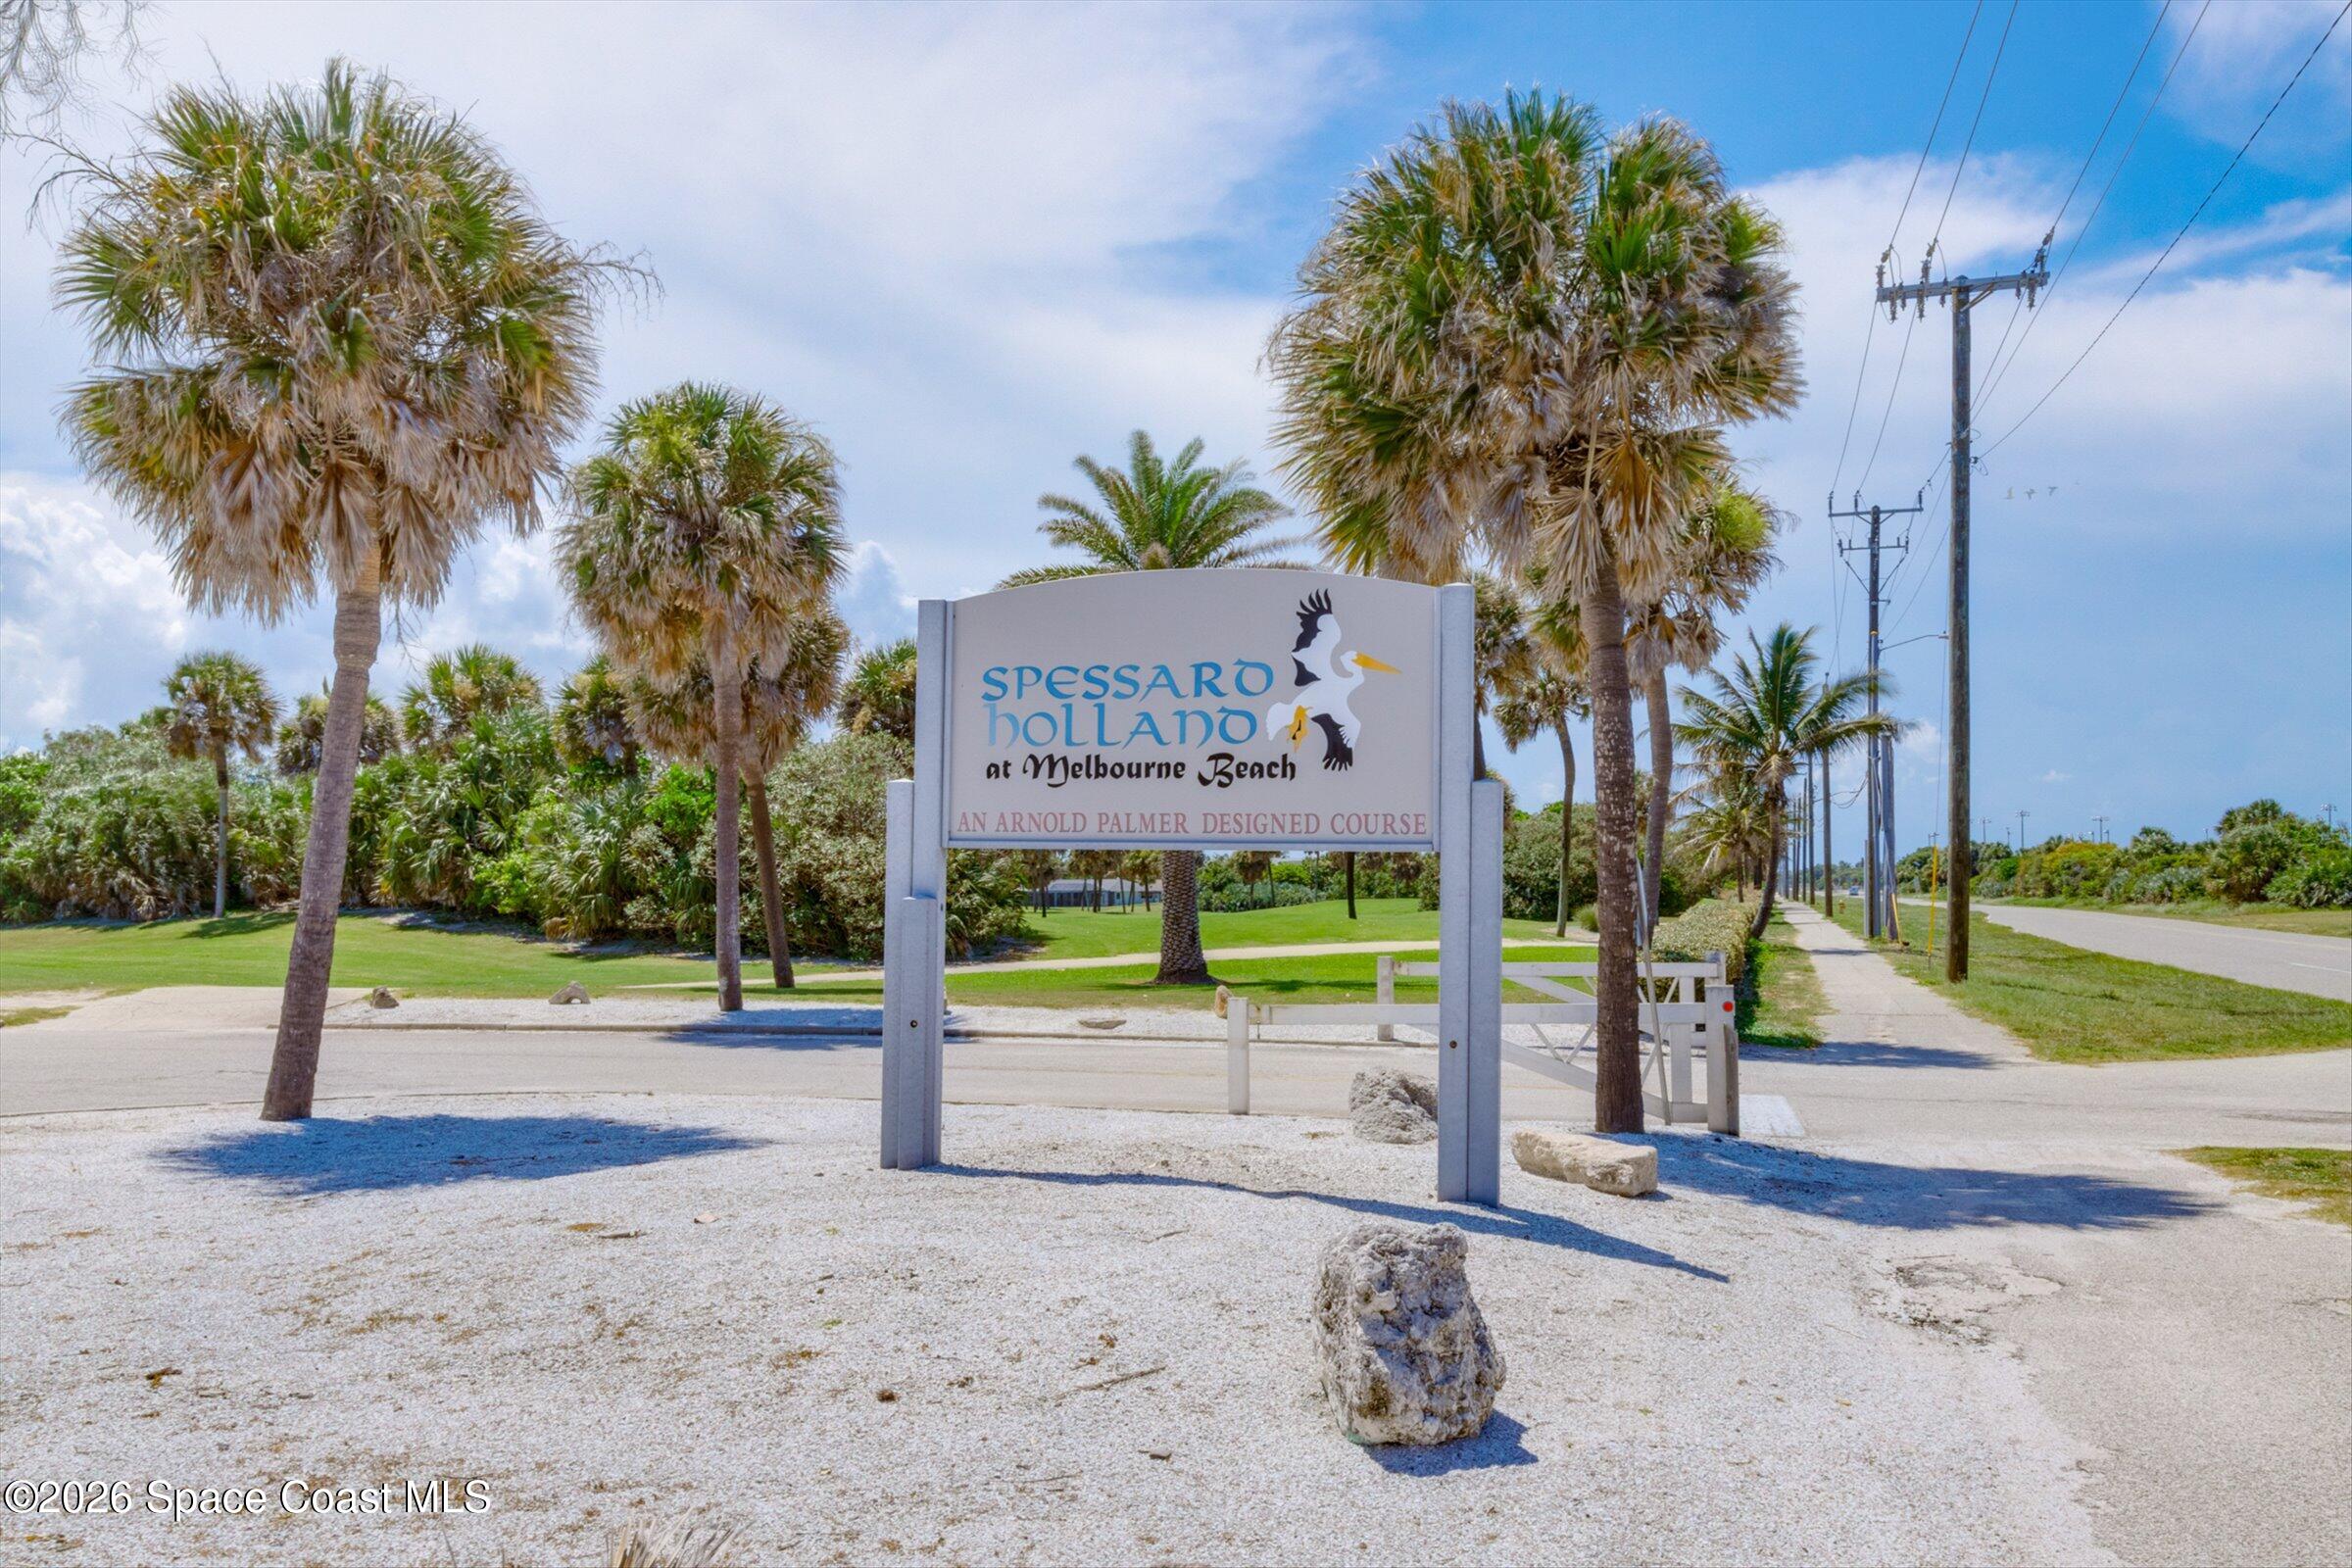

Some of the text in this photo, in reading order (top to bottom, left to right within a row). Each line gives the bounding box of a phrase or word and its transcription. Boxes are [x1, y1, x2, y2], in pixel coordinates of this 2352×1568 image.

[981, 659, 1274, 703] SPESSARD
[985, 752, 1297, 788] at Melbourne Beach
[956, 810, 1428, 836] AN ARNOLD PALMER DESIGNED COURSE
